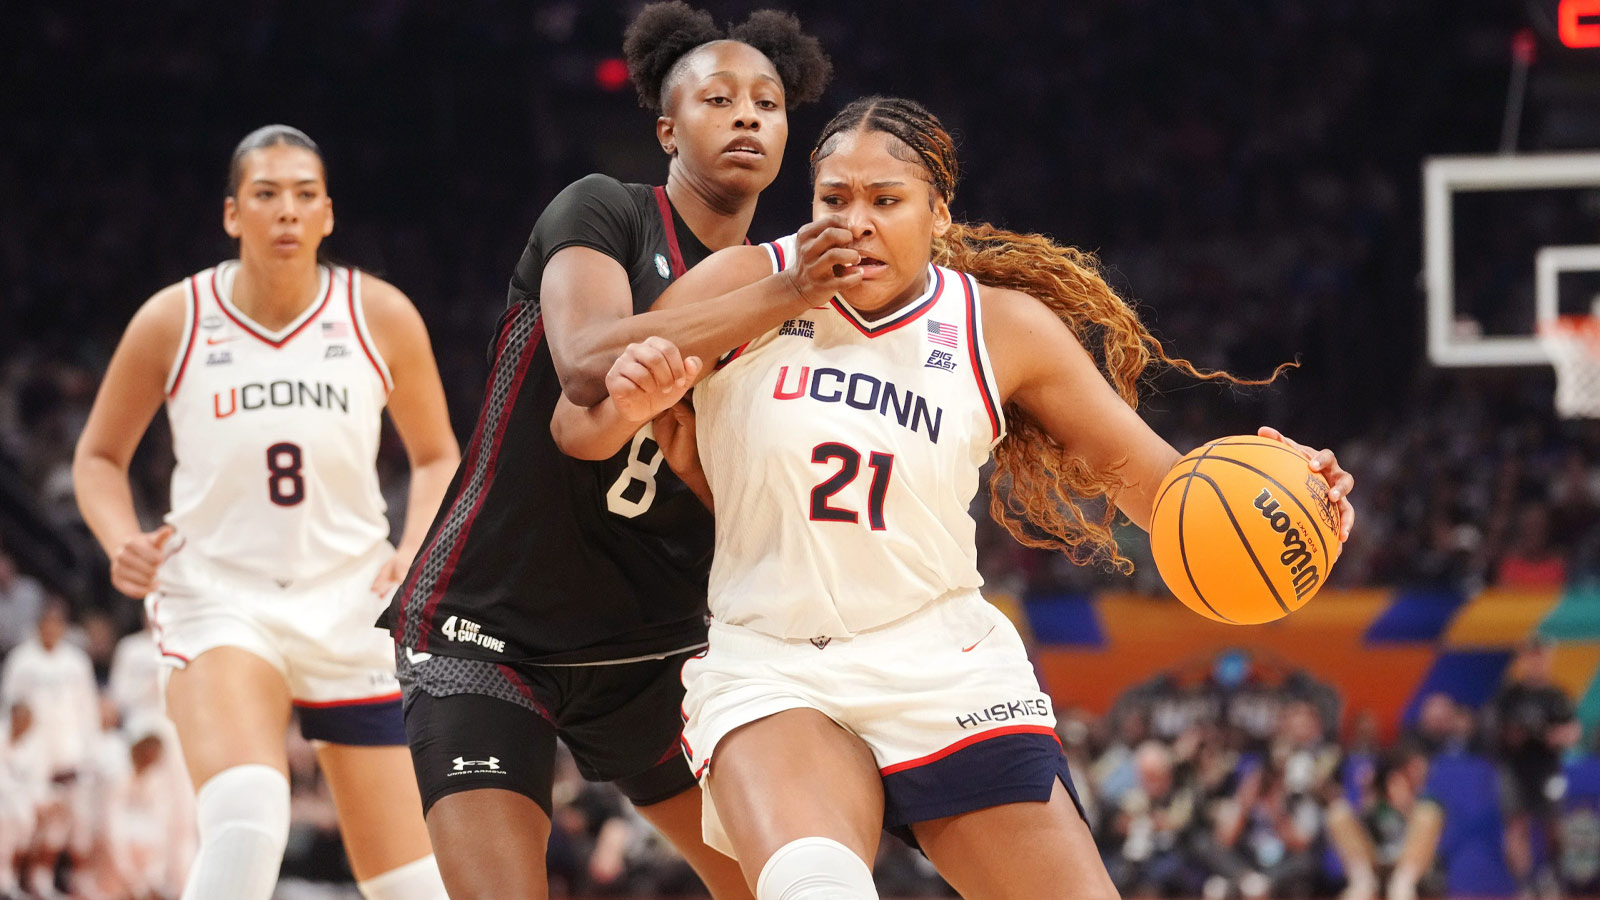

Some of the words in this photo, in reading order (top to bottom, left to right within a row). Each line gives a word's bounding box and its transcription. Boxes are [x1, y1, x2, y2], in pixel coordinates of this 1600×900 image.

[778, 327, 815, 339] CHANGE
[783, 319, 796, 328] BE
[798, 319, 815, 330] THE
[926, 356, 957, 370] EAST
[931, 349, 953, 361] BIG
[214, 380, 349, 419] UCONN
[773, 366, 943, 444] UCONN
[266, 441, 305, 507] 8
[606, 420, 664, 519] 8
[809, 442, 895, 531] 21
[1297, 521, 1309, 537] NXT
[1253, 488, 1319, 601] Wilson
[1307, 537, 1318, 554] EVO
[441, 615, 458, 642] 4
[460, 618, 481, 634] THE
[457, 629, 506, 653] CULTURE
[956, 698, 1048, 730] HUSKIES
